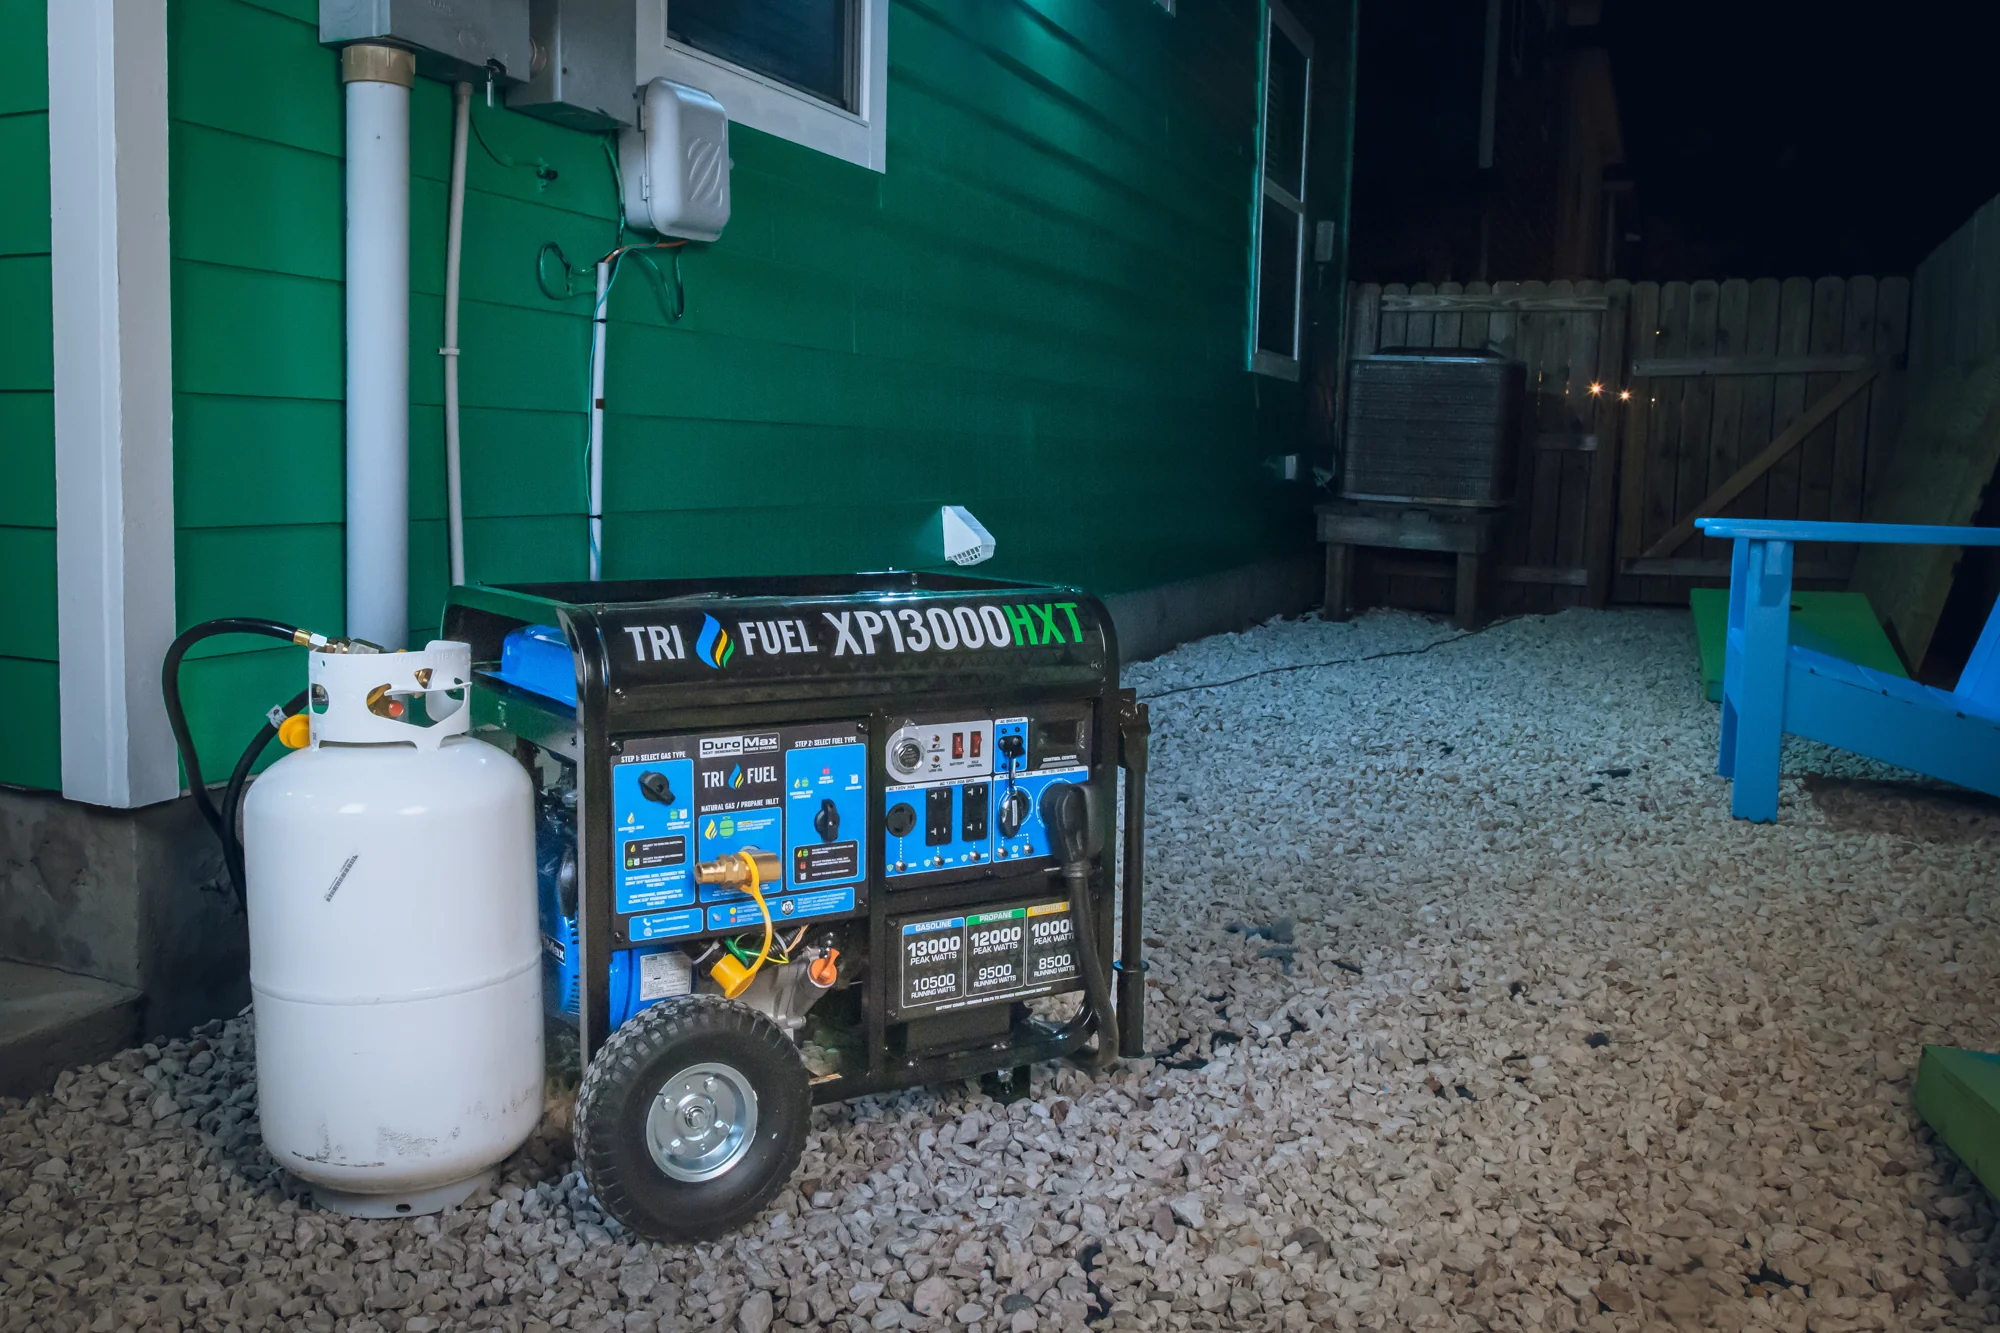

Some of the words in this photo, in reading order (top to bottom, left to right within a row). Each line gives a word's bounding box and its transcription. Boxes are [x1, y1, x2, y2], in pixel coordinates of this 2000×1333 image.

[623, 625, 686, 662] TRI
[738, 619, 818, 656] FUEL
[821, 602, 1083, 656] XP13000HXT
[702, 741, 740, 751] Duro
[744, 737, 778, 746] Max
[832, 737, 843, 745] FUEL
[621, 755, 635, 763] STEP
[641, 753, 660, 761] SELECT
[660, 752, 671, 760] GAS
[702, 770, 725, 788] TRI
[747, 766, 777, 784] FUEL
[701, 803, 724, 812] NATURAL
[725, 802, 735, 810] GAS
[741, 799, 763, 808] PROPANE
[765, 797, 779, 806] INLET
[979, 911, 1012, 923] PROPANE
[915, 920, 952, 932] GASOLINE
[971, 926, 1022, 947] 12000
[1033, 936, 1052, 945] PEAK
[907, 935, 960, 957] 13000
[973, 945, 992, 955] PEAK
[993, 942, 1018, 952] WATTS
[910, 957, 930, 966] PEAK
[931, 951, 957, 962] WATTS
[1038, 953, 1071, 970] 8500
[979, 963, 1012, 980] 9500
[1033, 968, 1057, 977] RUNNING
[1058, 964, 1075, 974] WATTS
[913, 973, 955, 991] 10500
[973, 977, 998, 988] RUNNING
[998, 975, 1016, 983] WATTS
[911, 989, 936, 999] RUNNING
[937, 986, 956, 995] WATTS
